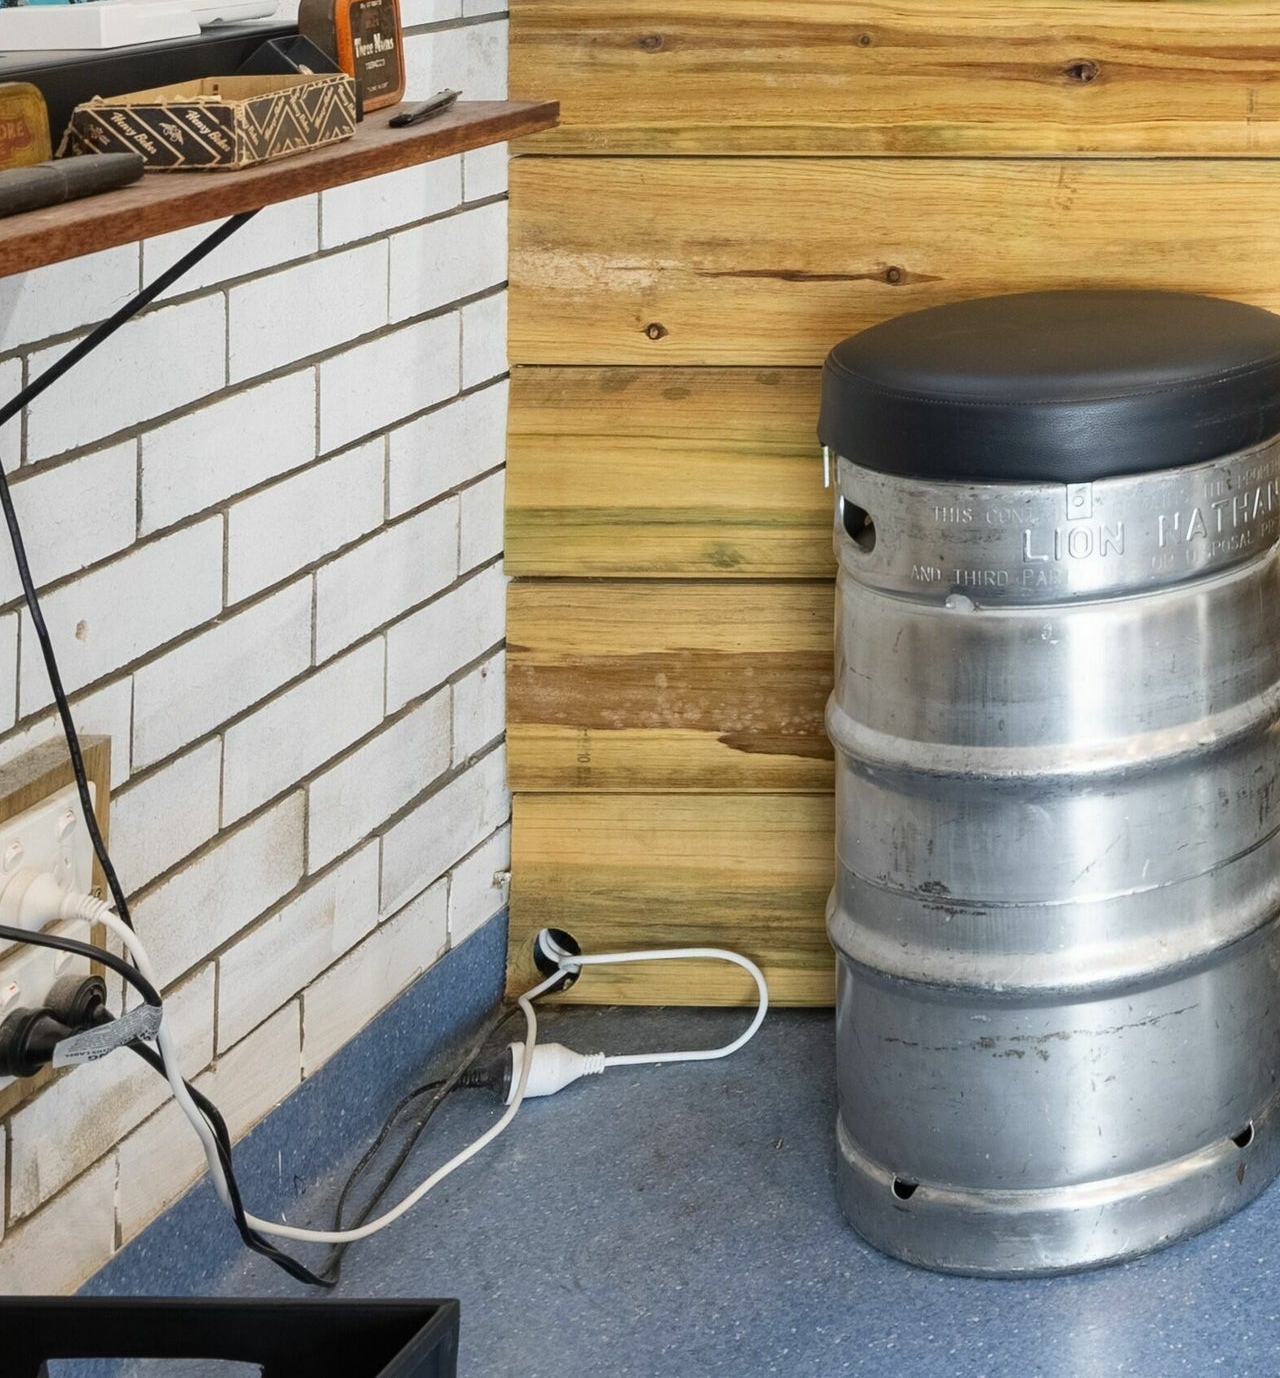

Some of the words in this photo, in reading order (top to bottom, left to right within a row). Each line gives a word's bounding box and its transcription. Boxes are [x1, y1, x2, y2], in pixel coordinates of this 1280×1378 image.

[110, 112, 137, 137] Henry
[184, 110, 212, 134] Henry
[1022, 522, 1126, 564] LION
[952, 568, 1009, 586] THIRD
